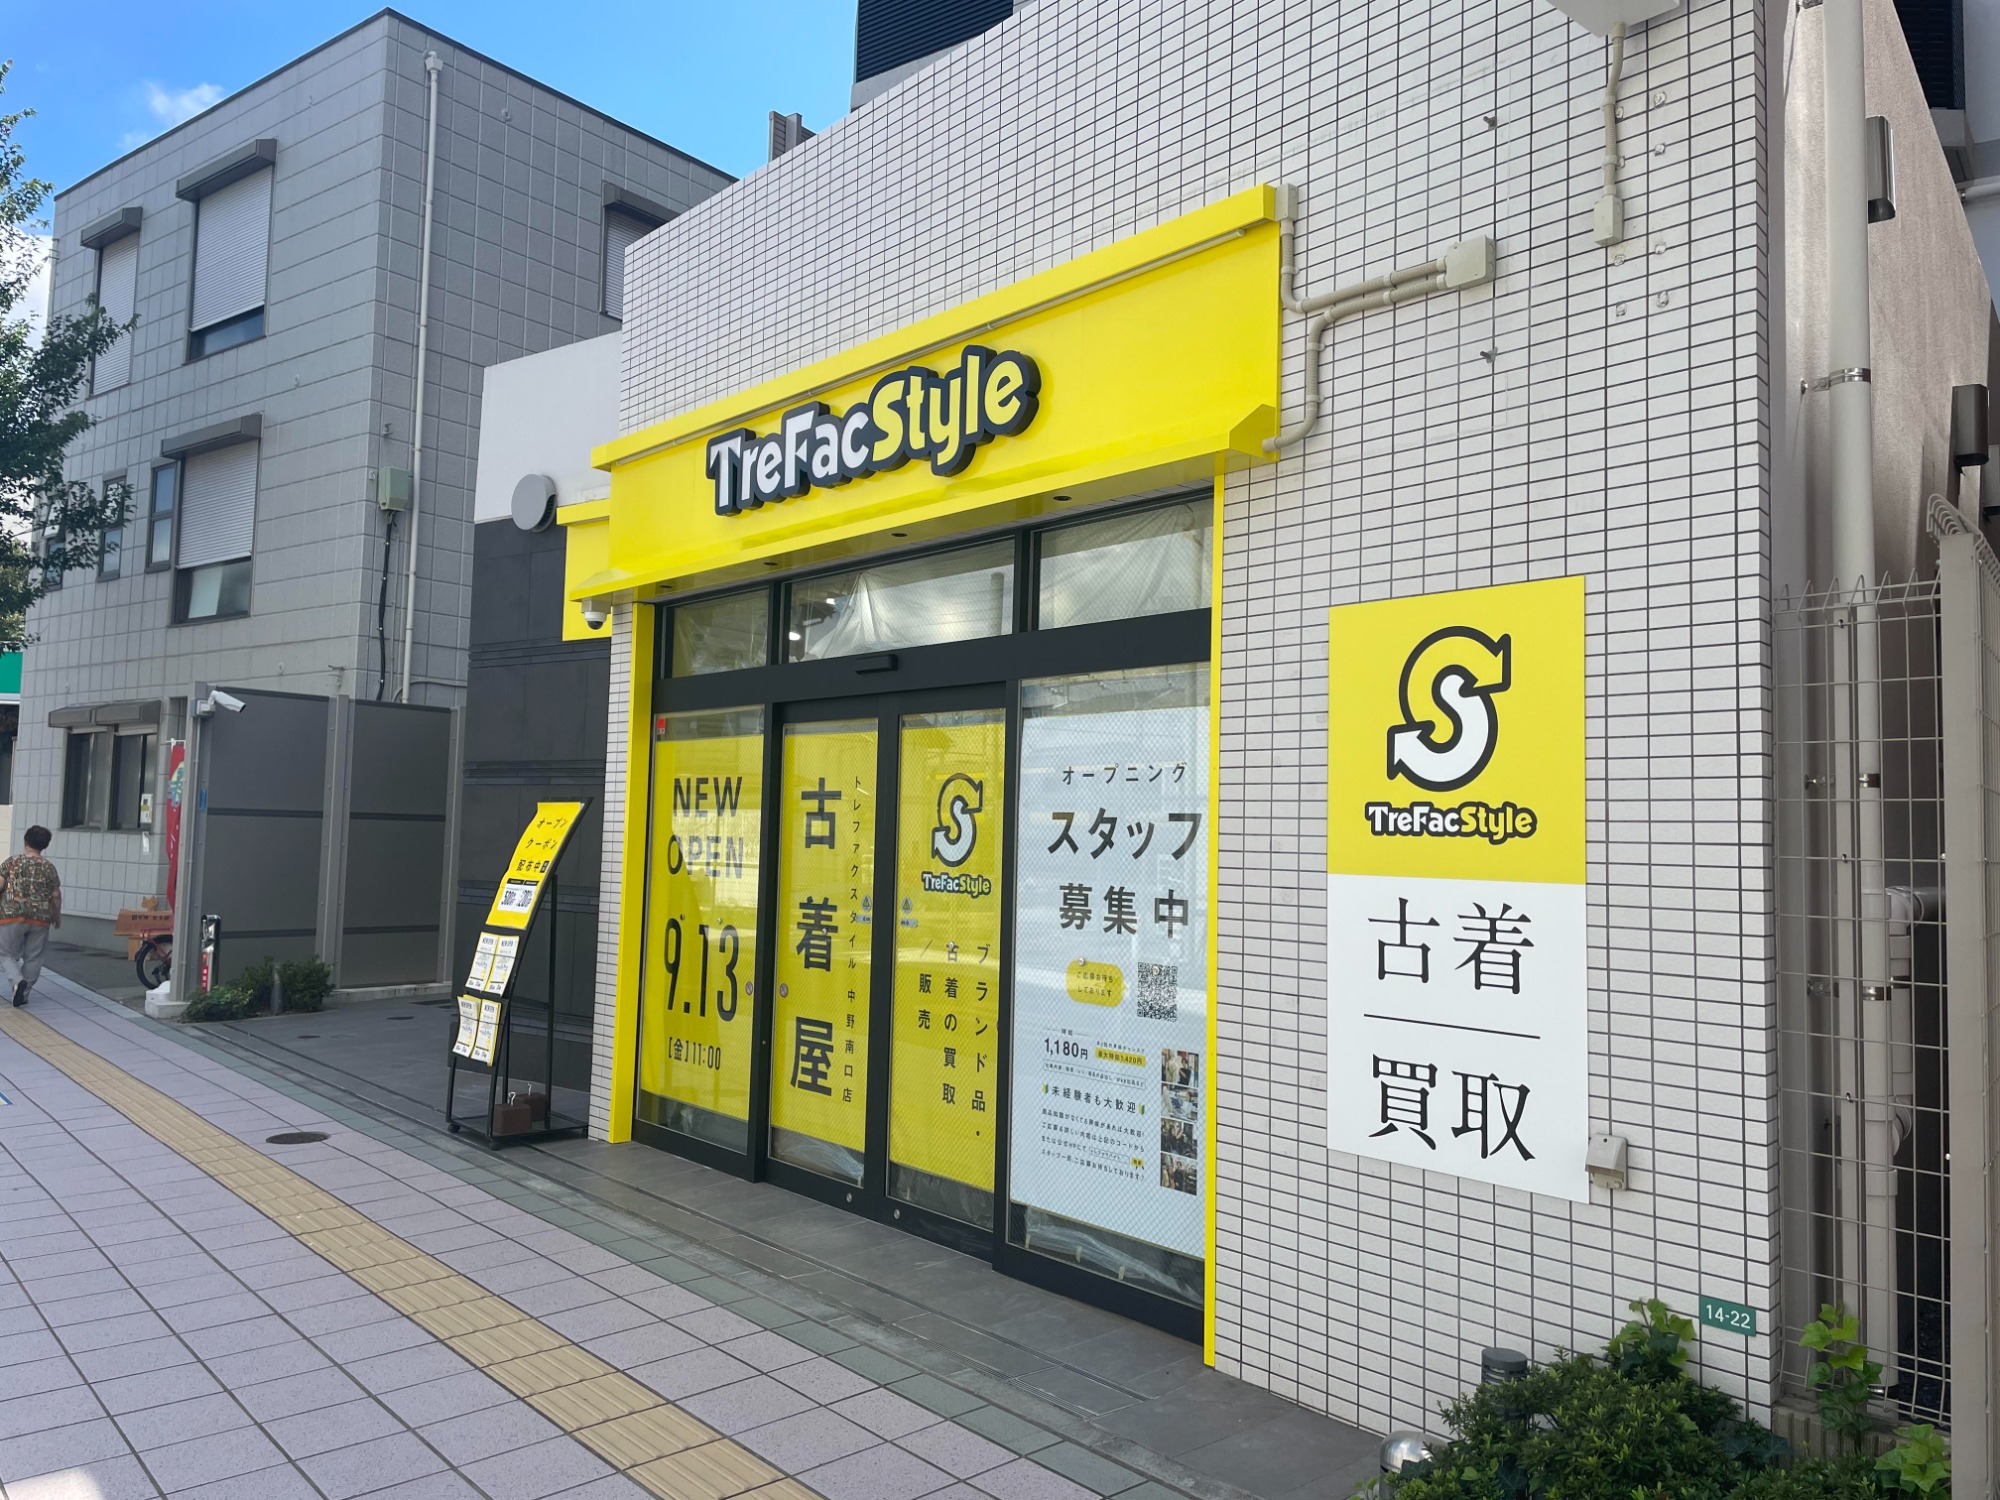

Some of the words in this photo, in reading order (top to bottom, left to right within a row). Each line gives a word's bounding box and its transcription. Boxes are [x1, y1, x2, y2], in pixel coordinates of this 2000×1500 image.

[708, 348, 1032, 512] TreFacStyle
[1062, 762, 1187, 785] オープニング
[672, 776, 743, 818] NEW
[525, 838, 558, 850] クーポン
[537, 817, 568, 829] オープン
[1047, 807, 1202, 861] スタッフ
[1365, 802, 1537, 845] TreFacStyle
[667, 834, 743, 879] OPEN
[848, 776, 861, 970] トレファクスタイル
[921, 871, 992, 899] TreFacStyle
[1059, 882, 1189, 939] 募集中
[790, 777, 842, 1097] 古着屋
[1367, 897, 1534, 995] 古着
[664, 917, 740, 1022] 9.13
[1077, 987, 1113, 998] しております
[842, 988, 856, 1103] 中野南口店
[942, 941, 958, 1105] 古着の買取
[1044, 1038, 1088, 1060] 1,180円
[1051, 1085, 1136, 1113] 未経験者も大歓迎
[1368, 1053, 1536, 1161] 買取
[1706, 1304, 1751, 1330] 14-22
